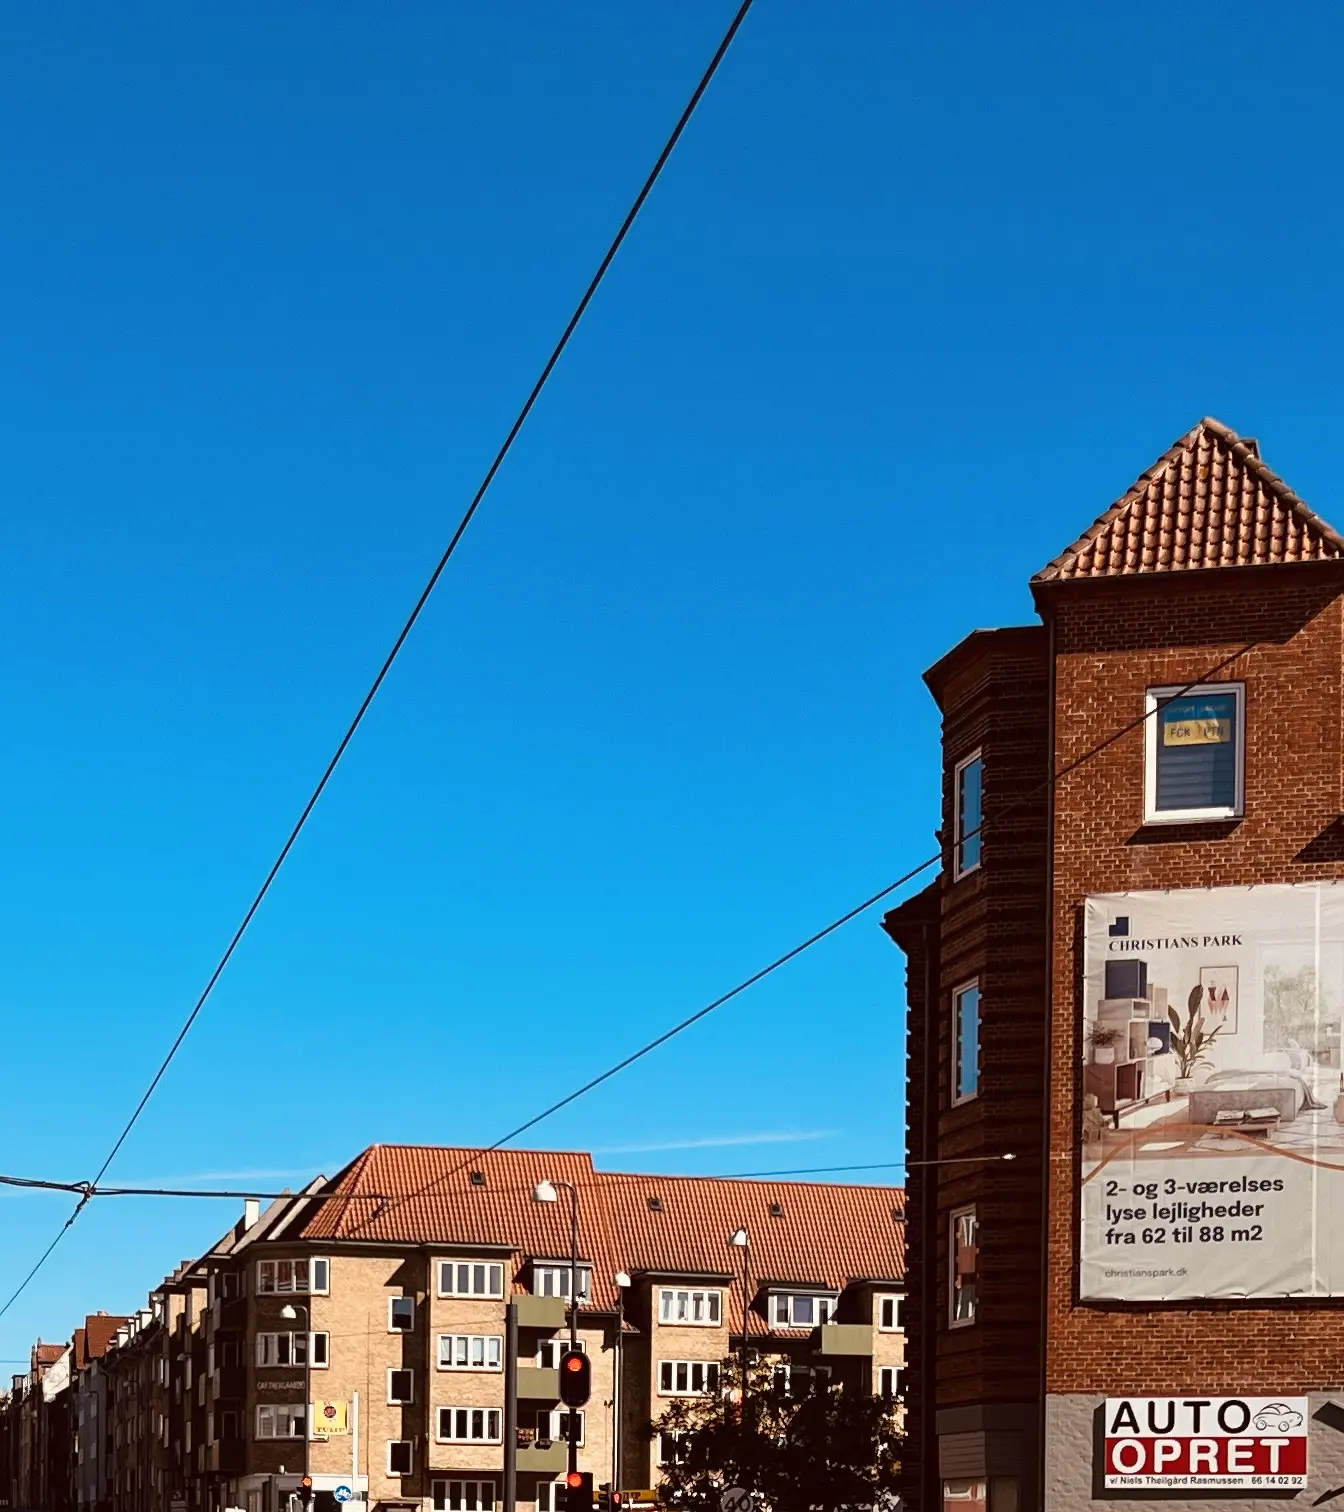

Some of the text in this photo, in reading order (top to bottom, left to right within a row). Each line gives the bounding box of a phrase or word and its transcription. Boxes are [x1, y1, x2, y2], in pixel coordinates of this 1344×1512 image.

[1109, 935, 1242, 952] CHRISTIANS PARK
[1106, 1176, 1284, 1200] 2- og 3-værelses
[1106, 1200, 1264, 1225] lyse lejligheder
[1105, 1225, 1263, 1245] fra 62 til 88 m2
[1104, 1267, 1188, 1279] christianspark.dk
[1110, 1400, 1251, 1434] AUTO
[1111, 1438, 1290, 1474] OPRET
[1120, 1476, 1143, 1485] Niels
[1190, 1476, 1244, 1485] Rasmussen
[1265, 1476, 1276, 1485] 14
[723, 1496, 750, 1510] 40
